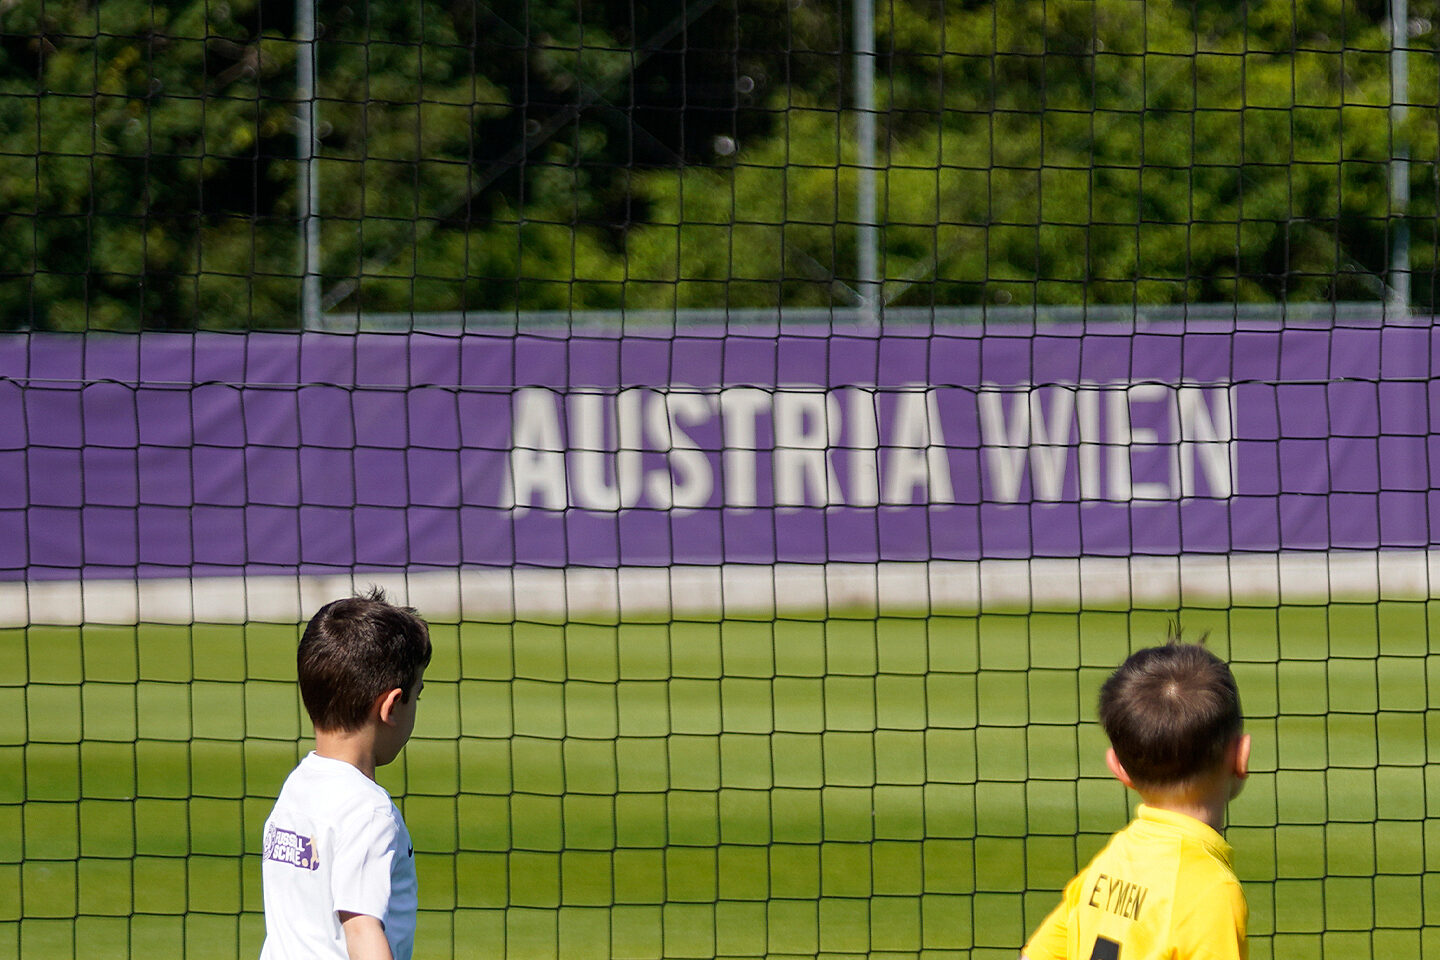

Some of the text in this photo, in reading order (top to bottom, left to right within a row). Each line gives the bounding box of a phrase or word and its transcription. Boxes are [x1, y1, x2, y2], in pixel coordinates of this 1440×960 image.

[501, 381, 1240, 515] AUSTRIA WIEN
[1089, 873, 1149, 921] EYMEN
